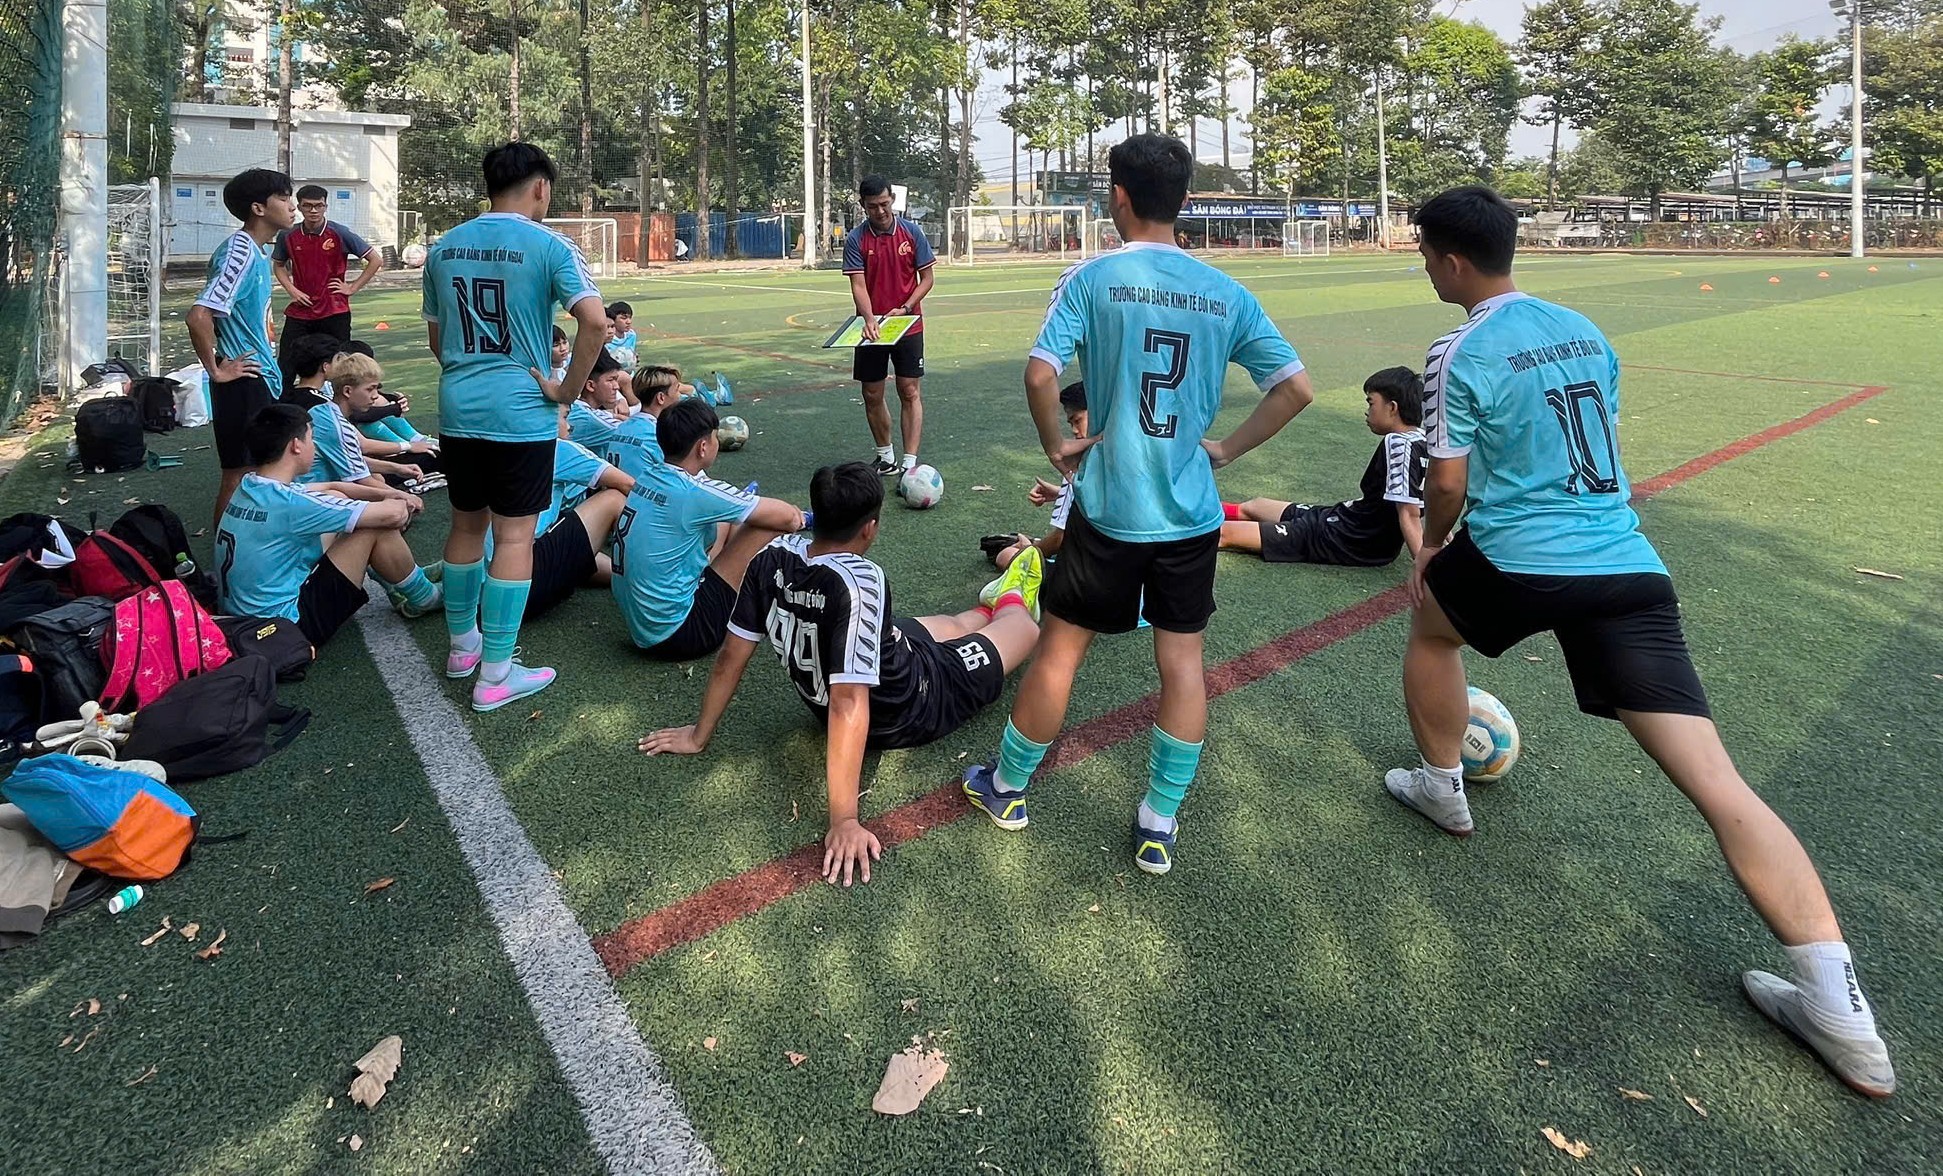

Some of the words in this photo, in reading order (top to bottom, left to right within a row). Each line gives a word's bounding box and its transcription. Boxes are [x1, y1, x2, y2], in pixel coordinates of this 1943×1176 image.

[452, 276, 512, 354] 19
[1137, 286, 1150, 304] CAO
[1170, 292, 1188, 310] KINH
[1139, 328, 1190, 438] 2
[1544, 380, 1619, 496] 10
[217, 528, 236, 598] 7
[612, 505, 637, 576] 8
[766, 598, 828, 706] 99
